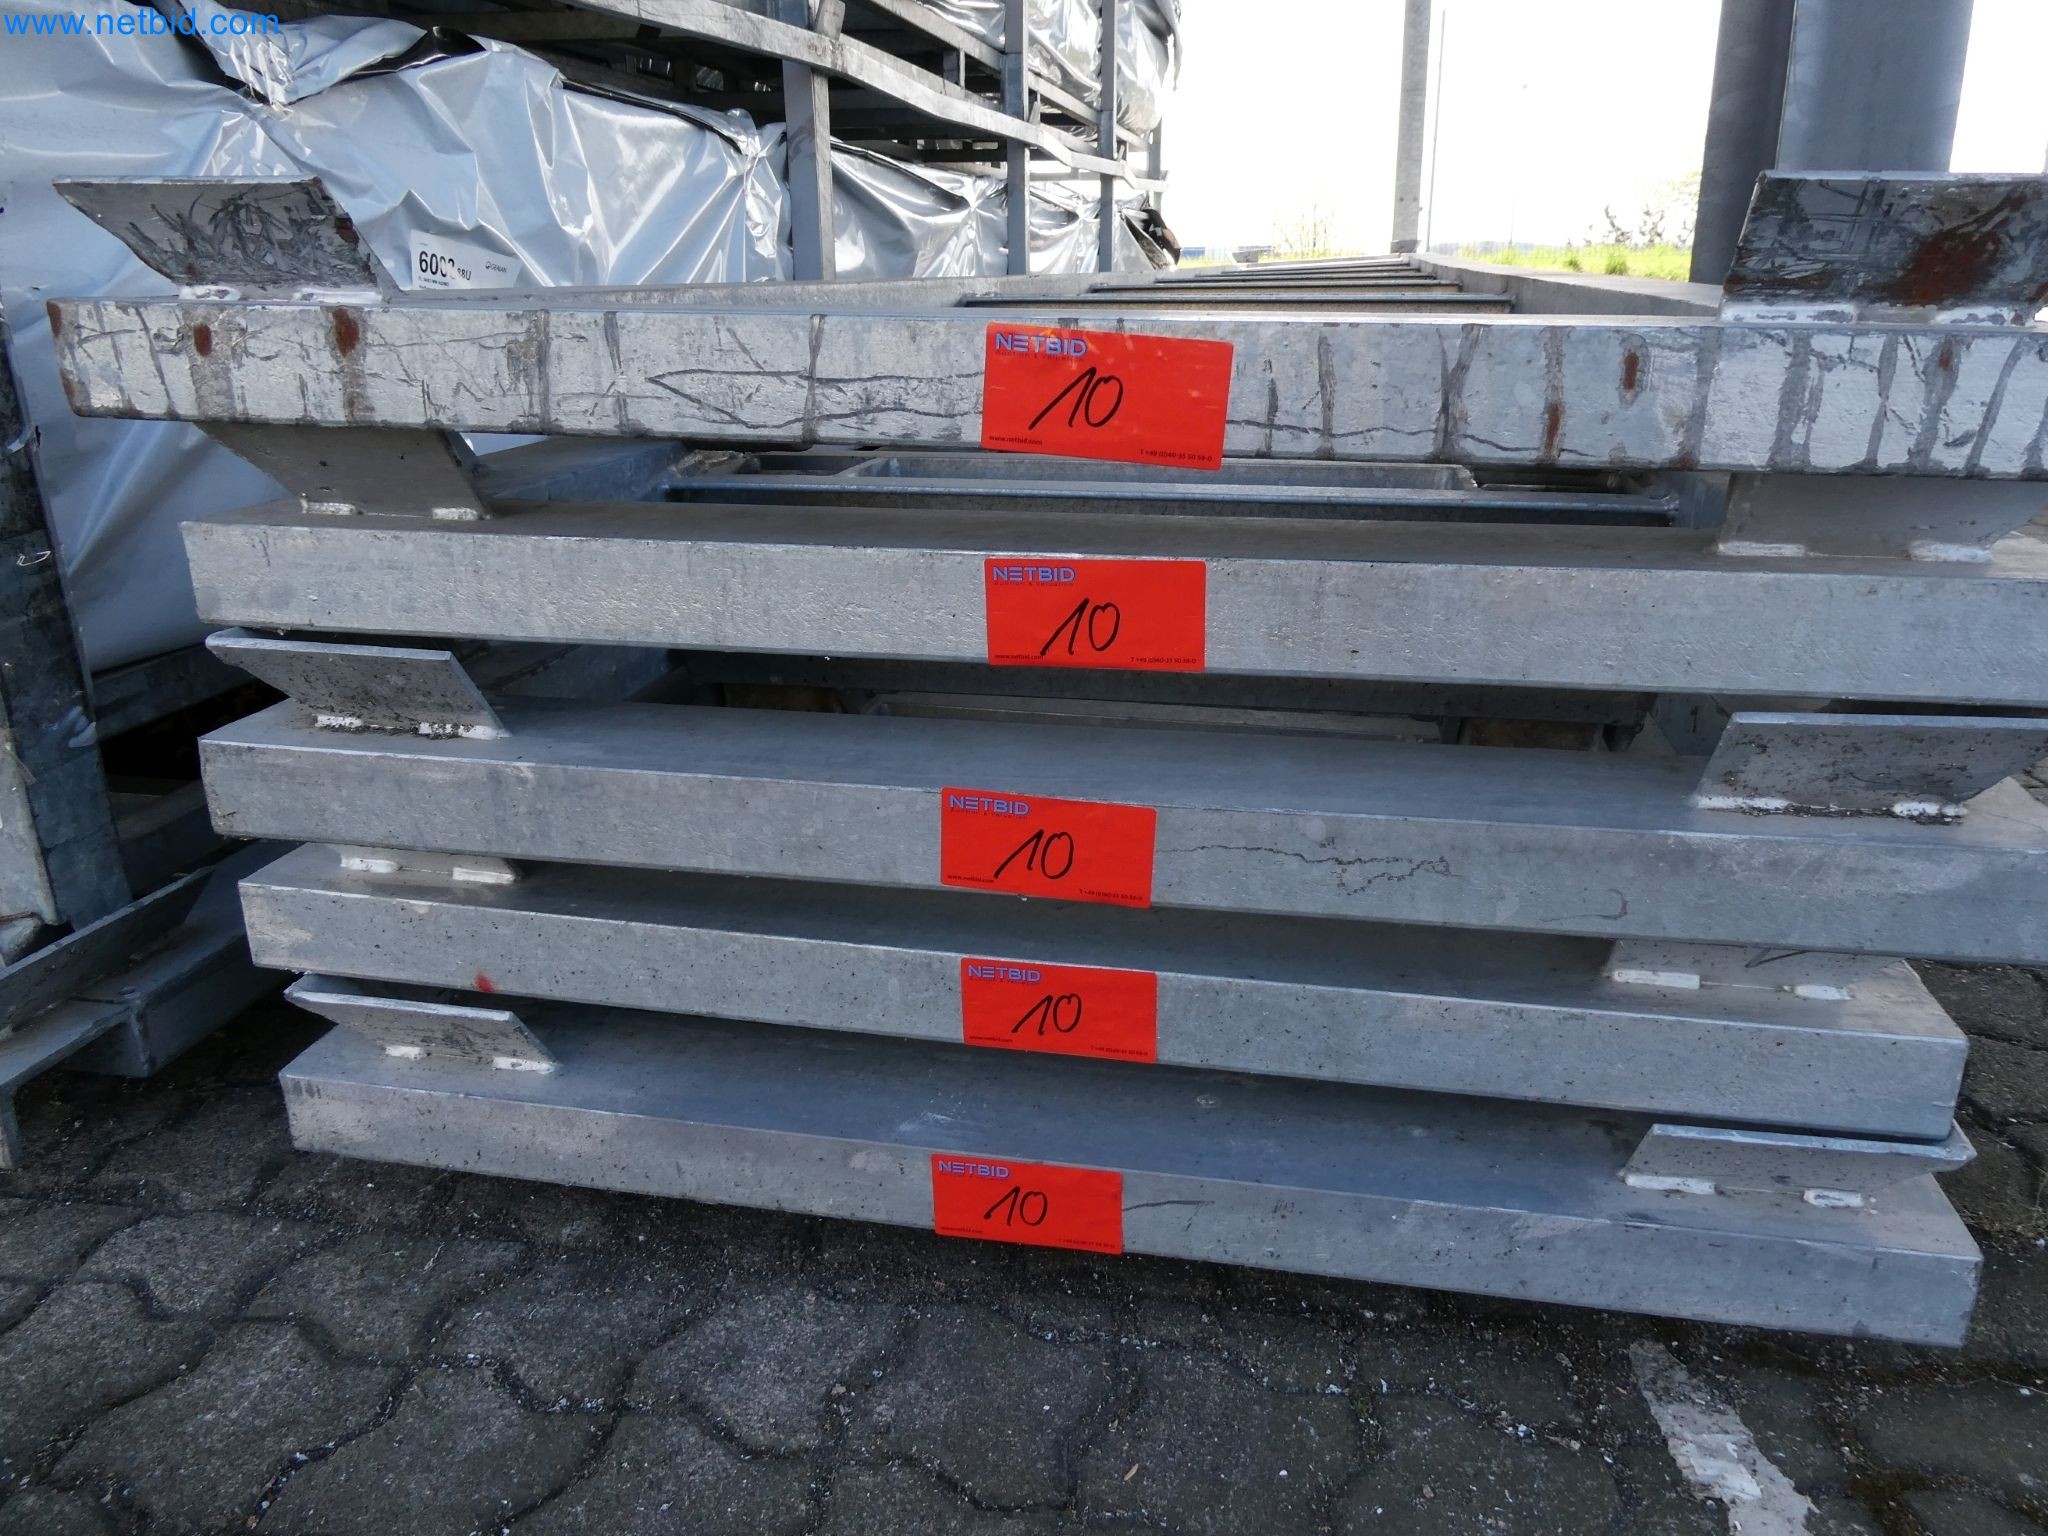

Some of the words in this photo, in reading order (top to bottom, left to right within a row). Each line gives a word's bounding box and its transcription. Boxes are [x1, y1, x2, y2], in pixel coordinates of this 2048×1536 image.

[995, 333, 1087, 357] NETBID
[1028, 366, 1123, 430] 10
[993, 566, 1076, 583] NETBID
[1040, 598, 1121, 655] 10
[949, 794, 1031, 816] NETBID
[993, 828, 1075, 880] 10
[968, 965, 1041, 983] NETBID
[1011, 993, 1083, 1036] 10
[938, 1160, 1010, 1180] NETBID
[983, 1186, 1049, 1227] 10
